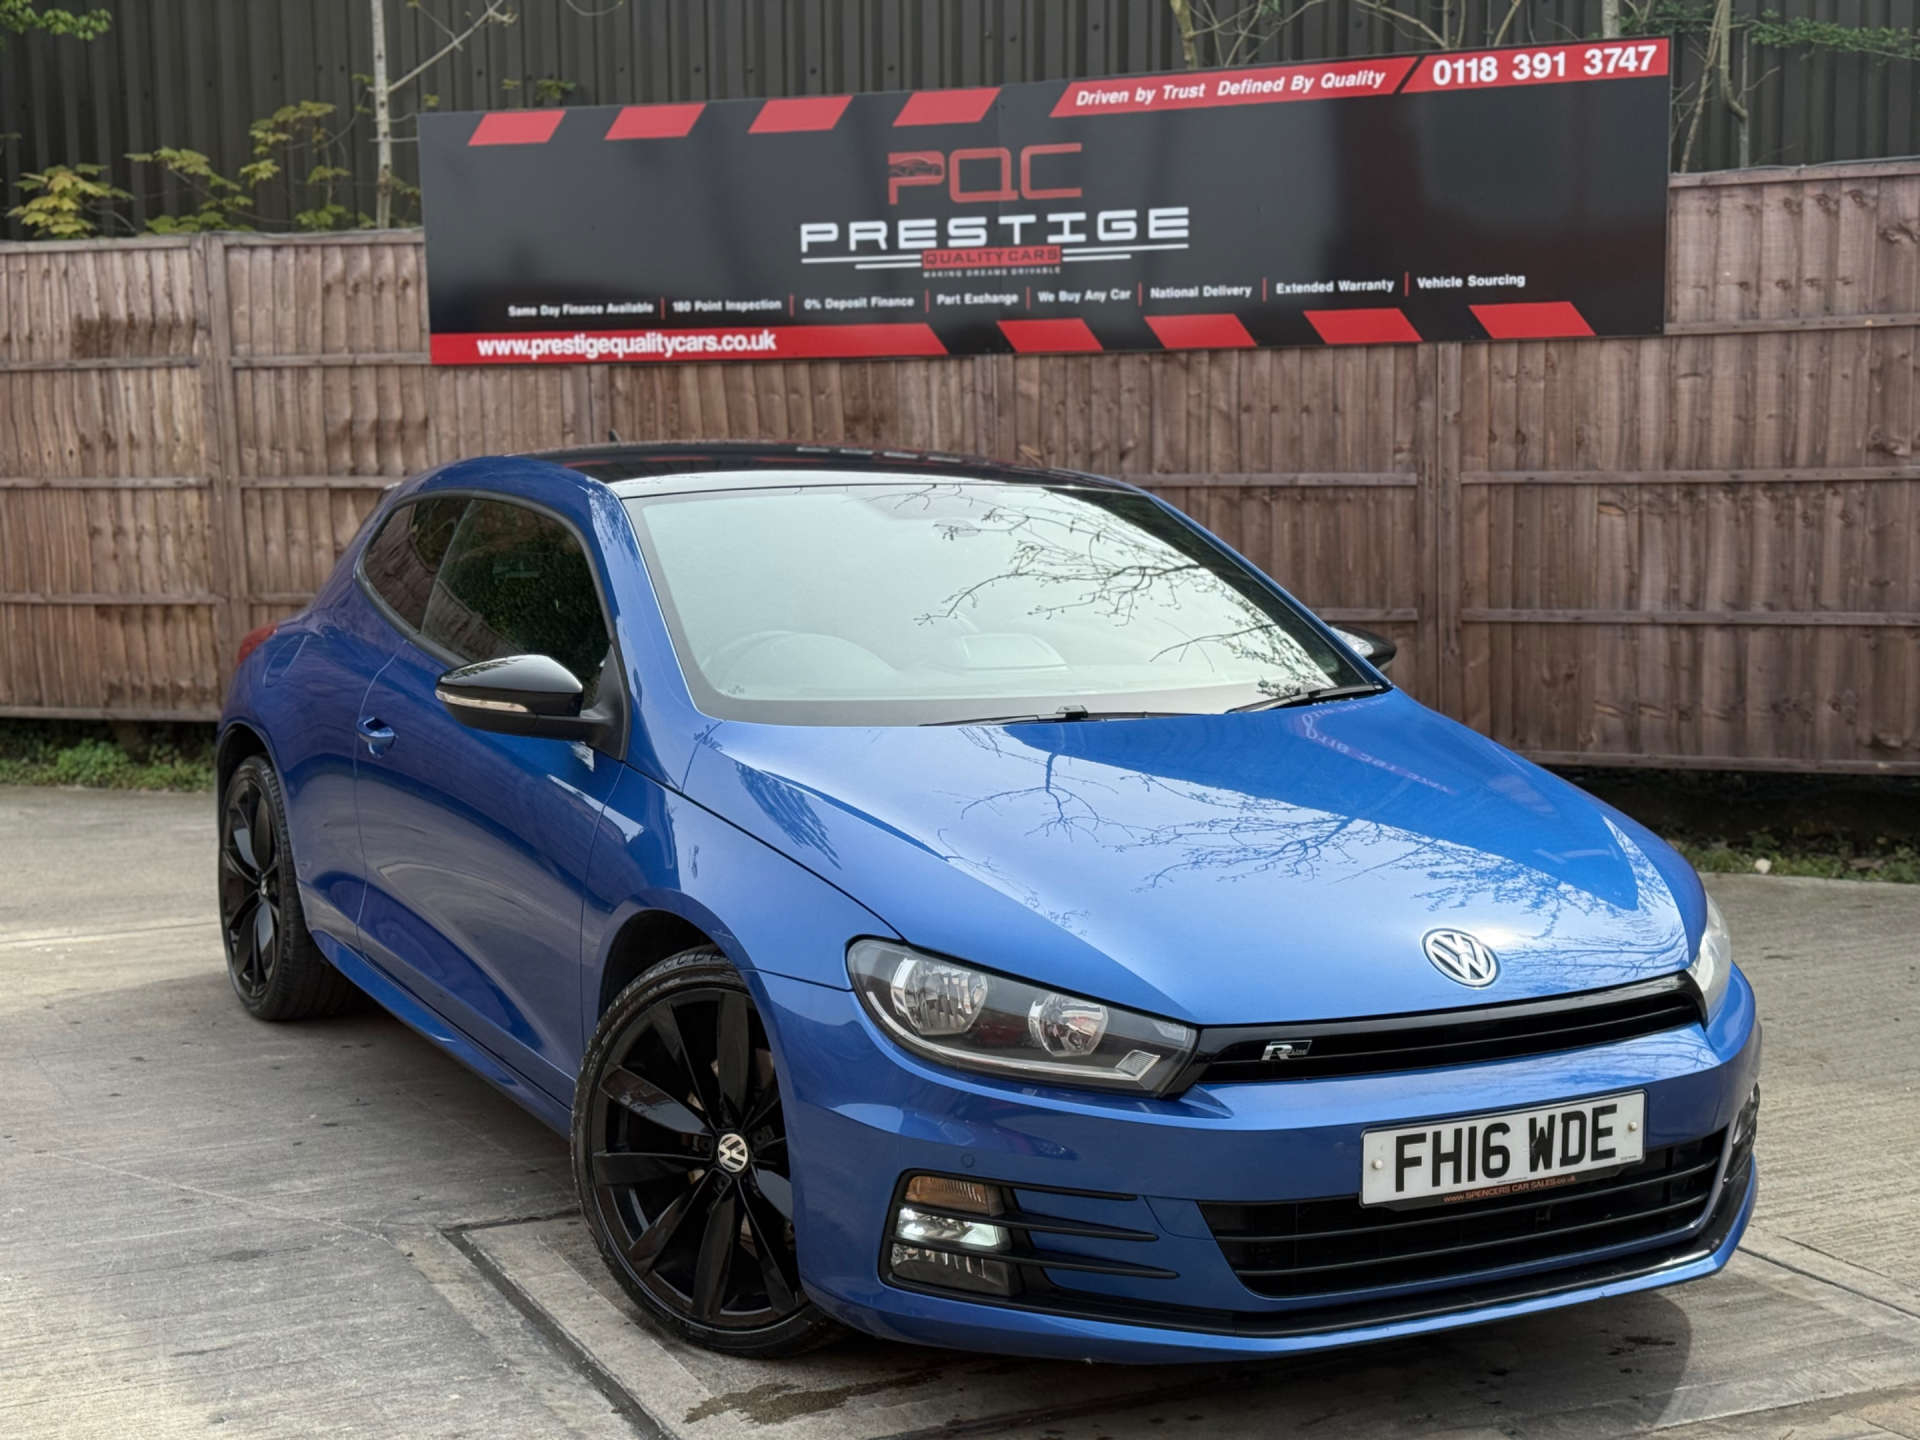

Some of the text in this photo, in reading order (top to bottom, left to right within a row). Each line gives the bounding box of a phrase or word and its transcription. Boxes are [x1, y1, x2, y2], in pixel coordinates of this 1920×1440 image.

[1433, 45, 1657, 86] 0118 391 3747
[1076, 70, 1386, 107] Driven by Trust Defined By Quality
[887, 142, 1083, 206] PQC
[800, 206, 1190, 254] PRESTIGE
[925, 248, 1058, 265] QUALITY CARS
[1276, 279, 1395, 295] Extended Warranty
[1416, 273, 1526, 289] Vehicle Sourcing
[937, 293, 1019, 306] Part Exchange
[1037, 288, 1132, 304] We Buy Any Car
[1150, 284, 1252, 299] National Delivery
[508, 302, 655, 318] Same Day Finance Available
[694, 300, 723, 312] Point
[725, 299, 783, 313] Inspection
[804, 297, 914, 311] 0% Deposit Finance
[477, 330, 778, 361] www.prestigequalitycars.co.uk
[1395, 1103, 1618, 1193] FH16 WDE
[1511, 1181, 1530, 1193] CAR
